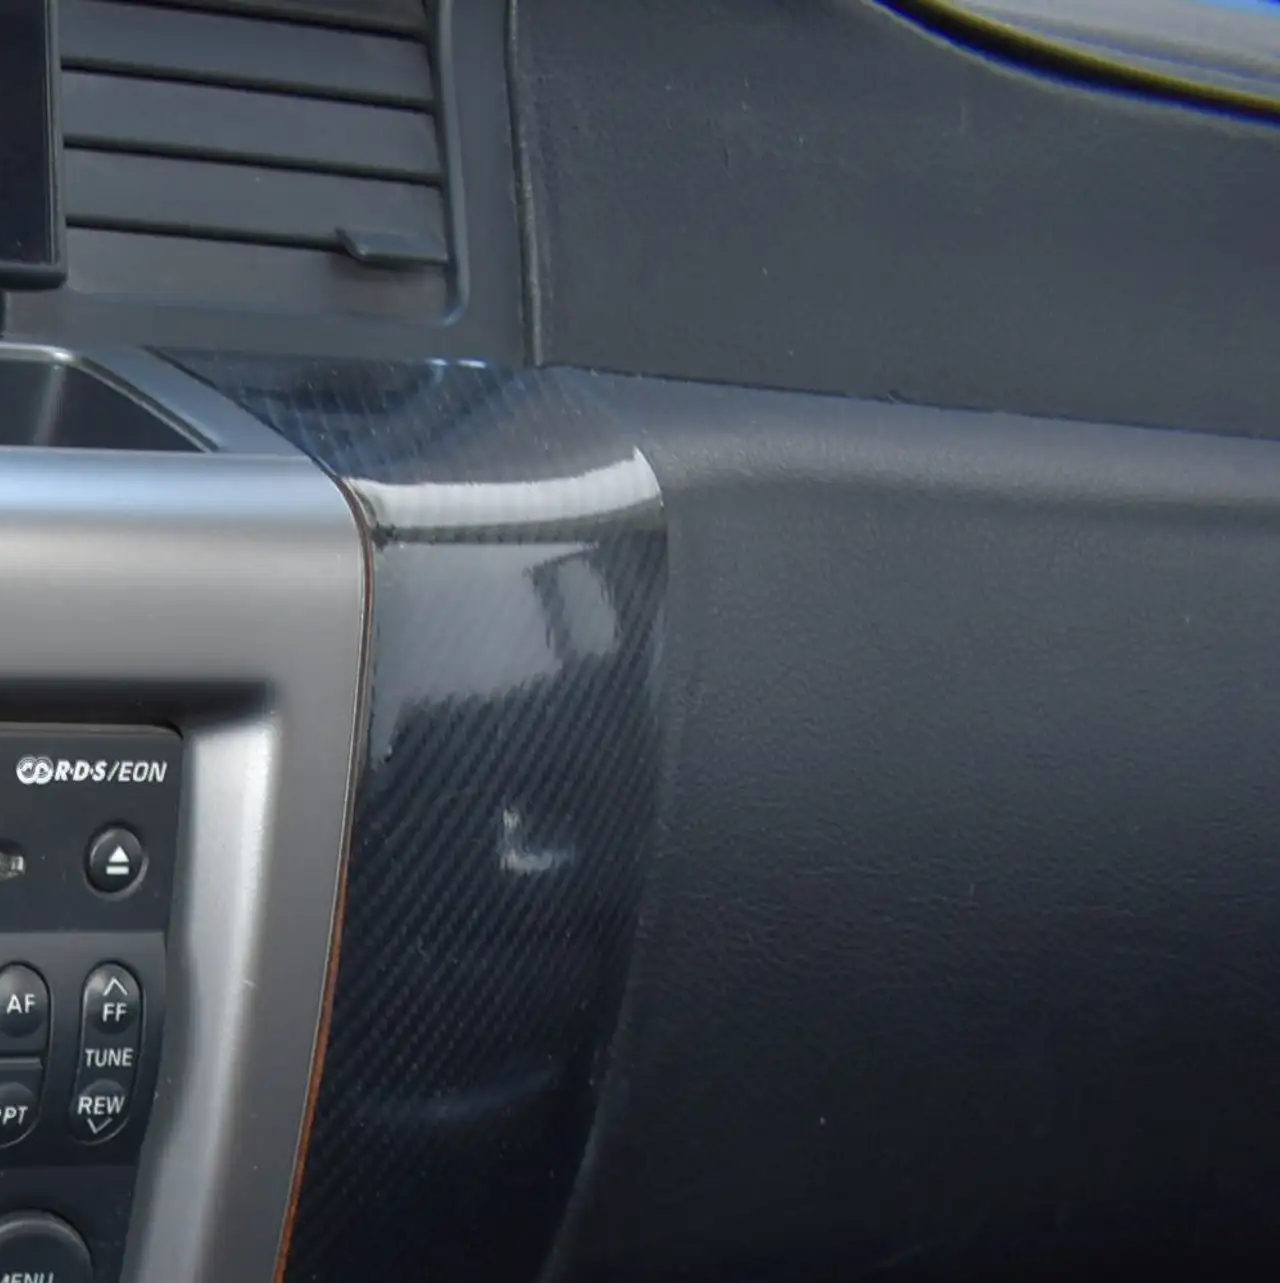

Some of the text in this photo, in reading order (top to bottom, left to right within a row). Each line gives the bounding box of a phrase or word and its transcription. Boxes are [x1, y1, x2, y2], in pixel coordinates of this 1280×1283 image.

[5, 993, 37, 1015] AF
[102, 1001, 127, 1022] FF
[85, 1047, 134, 1068] TUNE
[77, 1095, 125, 1115] REW
